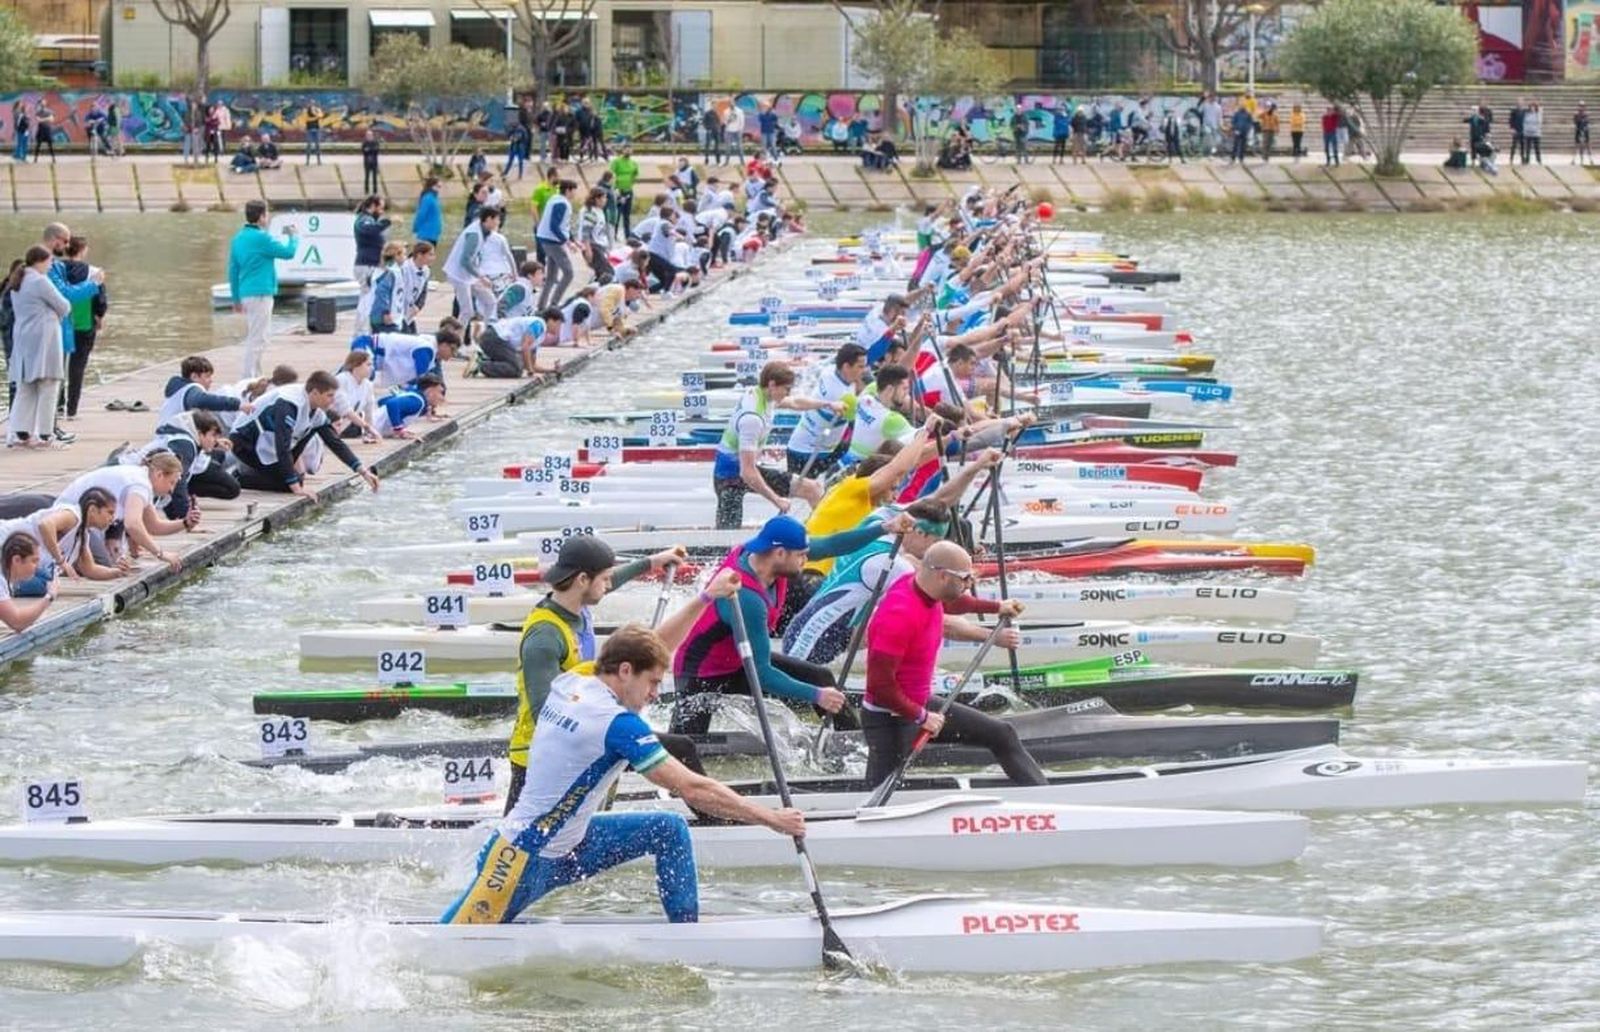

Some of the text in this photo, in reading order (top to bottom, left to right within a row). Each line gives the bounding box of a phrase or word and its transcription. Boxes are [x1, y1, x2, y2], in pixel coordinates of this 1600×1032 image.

[308, 215, 320, 232] 9
[749, 350, 768, 360] 825
[737, 363, 757, 373] 826
[1051, 383, 1073, 394] 829
[1184, 385, 1222, 396] ELIO
[683, 395, 708, 407] 830
[653, 412, 677, 424] 831
[650, 425, 676, 437] 832
[592, 436, 619, 449] 833
[543, 456, 571, 469] 834
[1017, 462, 1054, 473] SONIC
[525, 470, 554, 483] 835
[560, 480, 590, 494] 836
[1024, 501, 1064, 513] SONIC
[1175, 505, 1228, 515] ELIO
[468, 514, 500, 532] 837
[1125, 520, 1180, 532] ELIO
[541, 538, 565, 554] 83
[475, 564, 512, 581] 840
[1080, 588, 1126, 603] SONIC
[1196, 587, 1258, 599] ELIO
[427, 596, 465, 614] 841
[1078, 632, 1130, 648] SONIC
[1217, 632, 1287, 644] ELIO
[380, 652, 423, 672] 842
[1114, 649, 1142, 667] ESP
[261, 720, 308, 743] 843
[444, 758, 495, 784] 844
[27, 782, 81, 808] 845
[952, 814, 1057, 834] PLASTEX
[487, 845, 518, 893] CMIS
[962, 913, 1080, 934] PLASTEX
